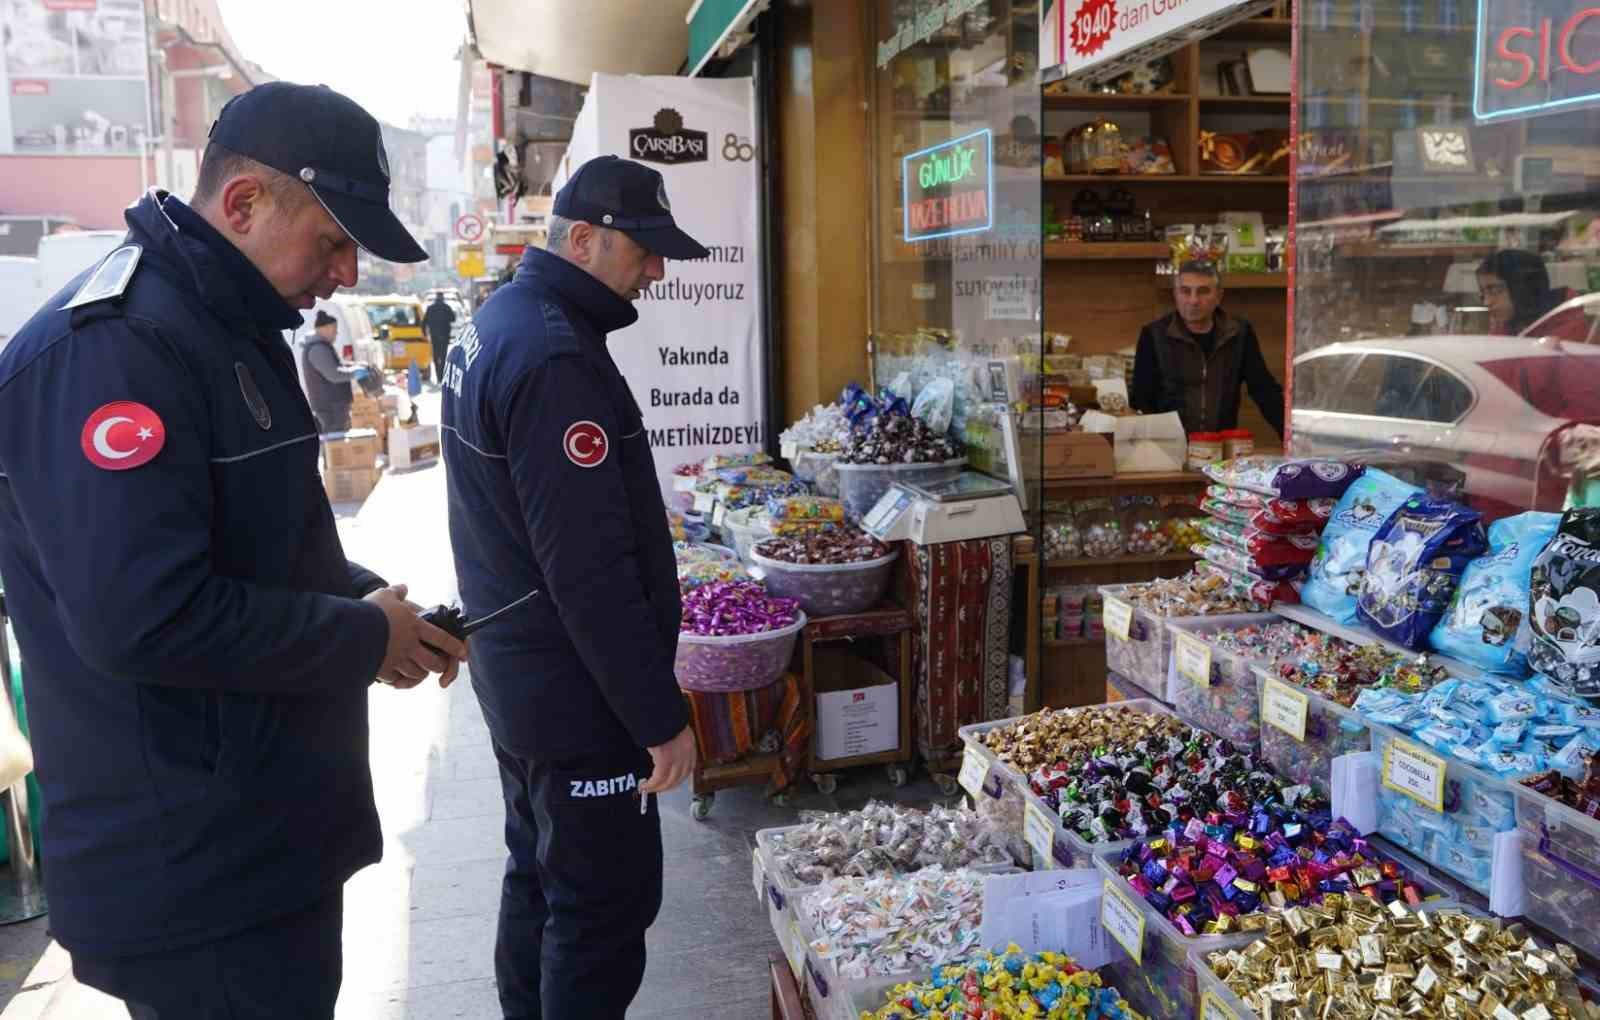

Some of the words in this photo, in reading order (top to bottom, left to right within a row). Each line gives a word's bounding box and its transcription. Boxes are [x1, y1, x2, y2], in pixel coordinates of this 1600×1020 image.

[1075, 2, 1111, 46] 1940
[1120, 3, 1149, 31] dan
[658, 346, 729, 366] Yakında
[651, 387, 713, 407] Burada
[719, 386, 740, 405] da
[570, 773, 636, 797] ZABITA
